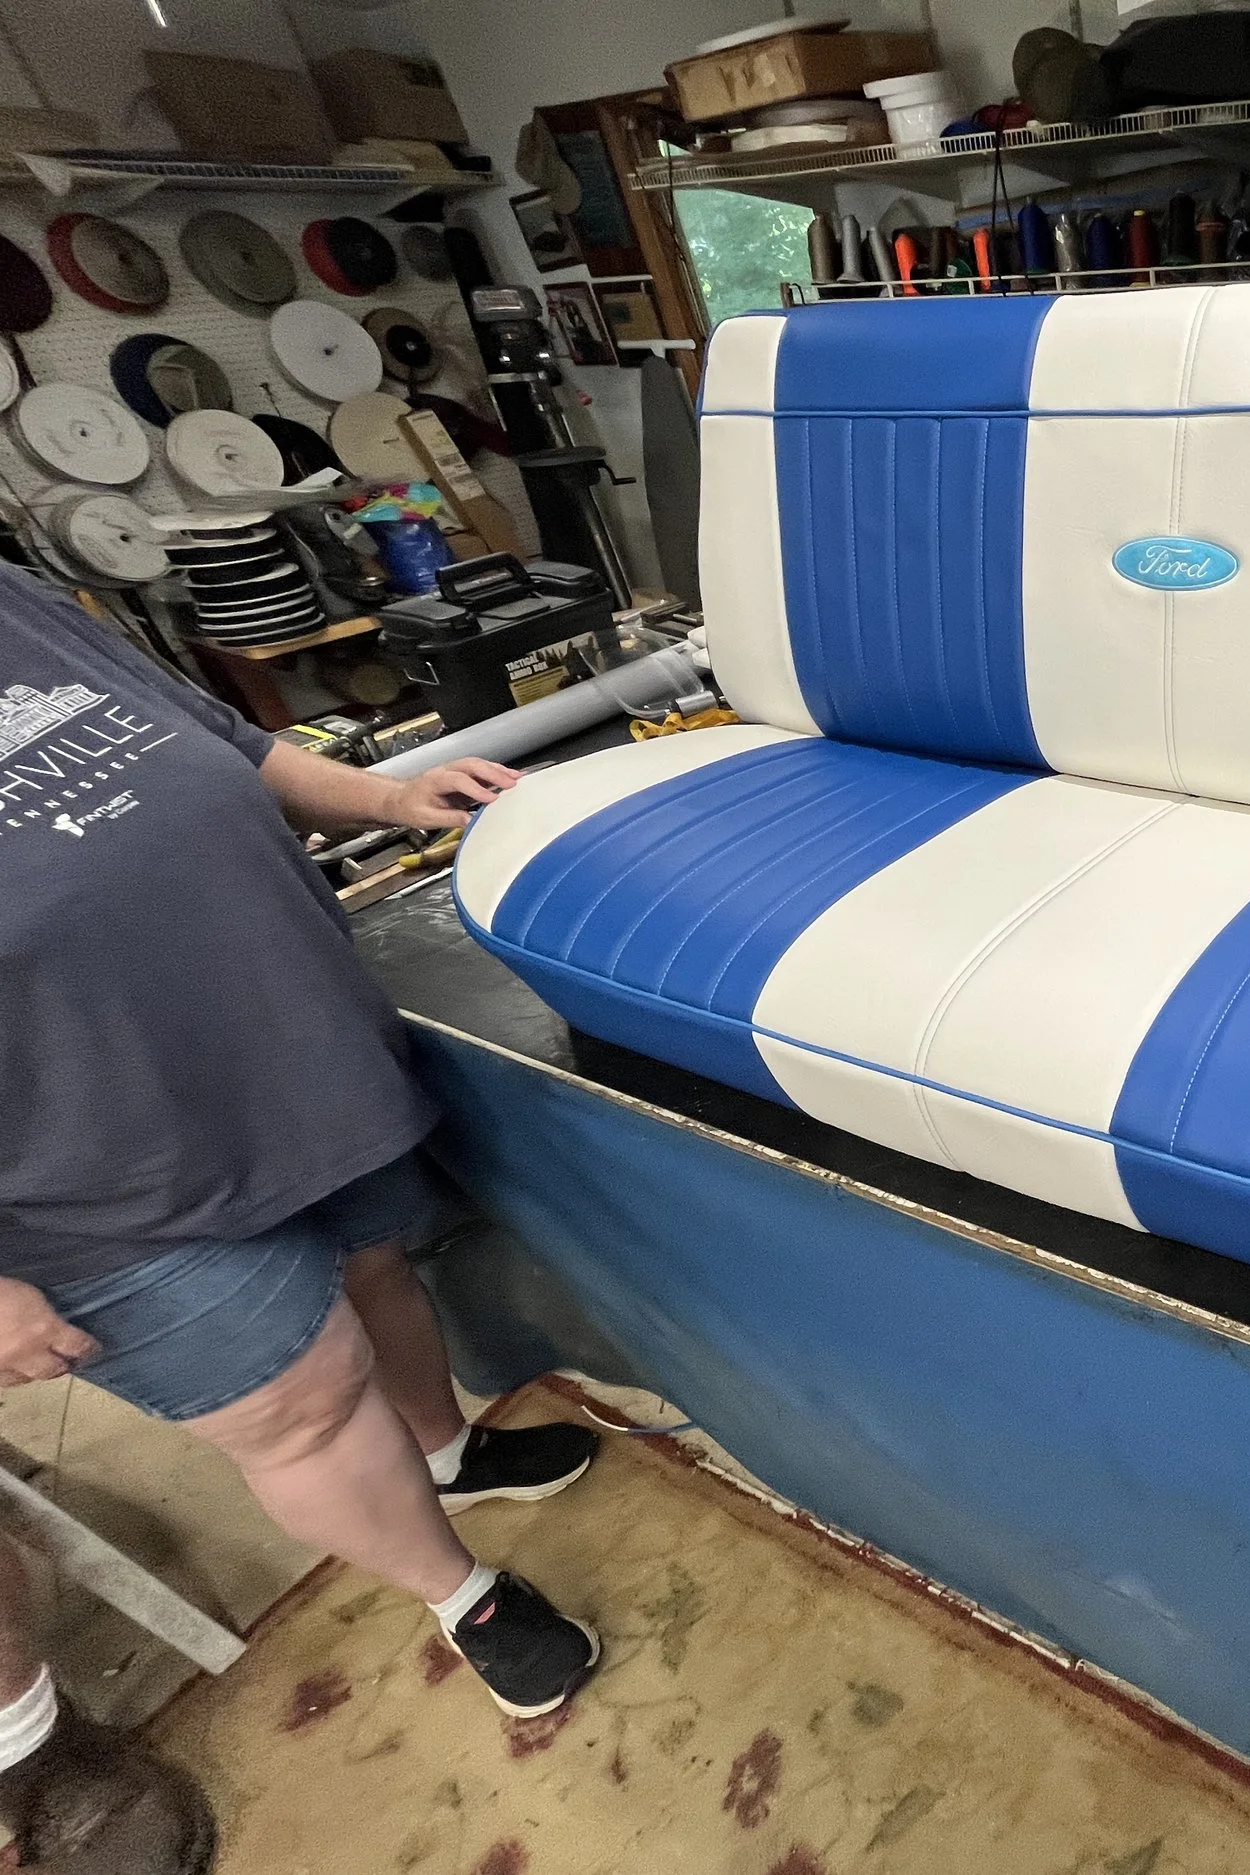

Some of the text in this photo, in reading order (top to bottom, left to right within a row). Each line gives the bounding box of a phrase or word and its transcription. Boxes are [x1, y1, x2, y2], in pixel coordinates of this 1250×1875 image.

[1138, 545, 1211, 578] Ford
[0, 705, 154, 811] HVILLE
[0, 752, 139, 836] ENNESSEE
